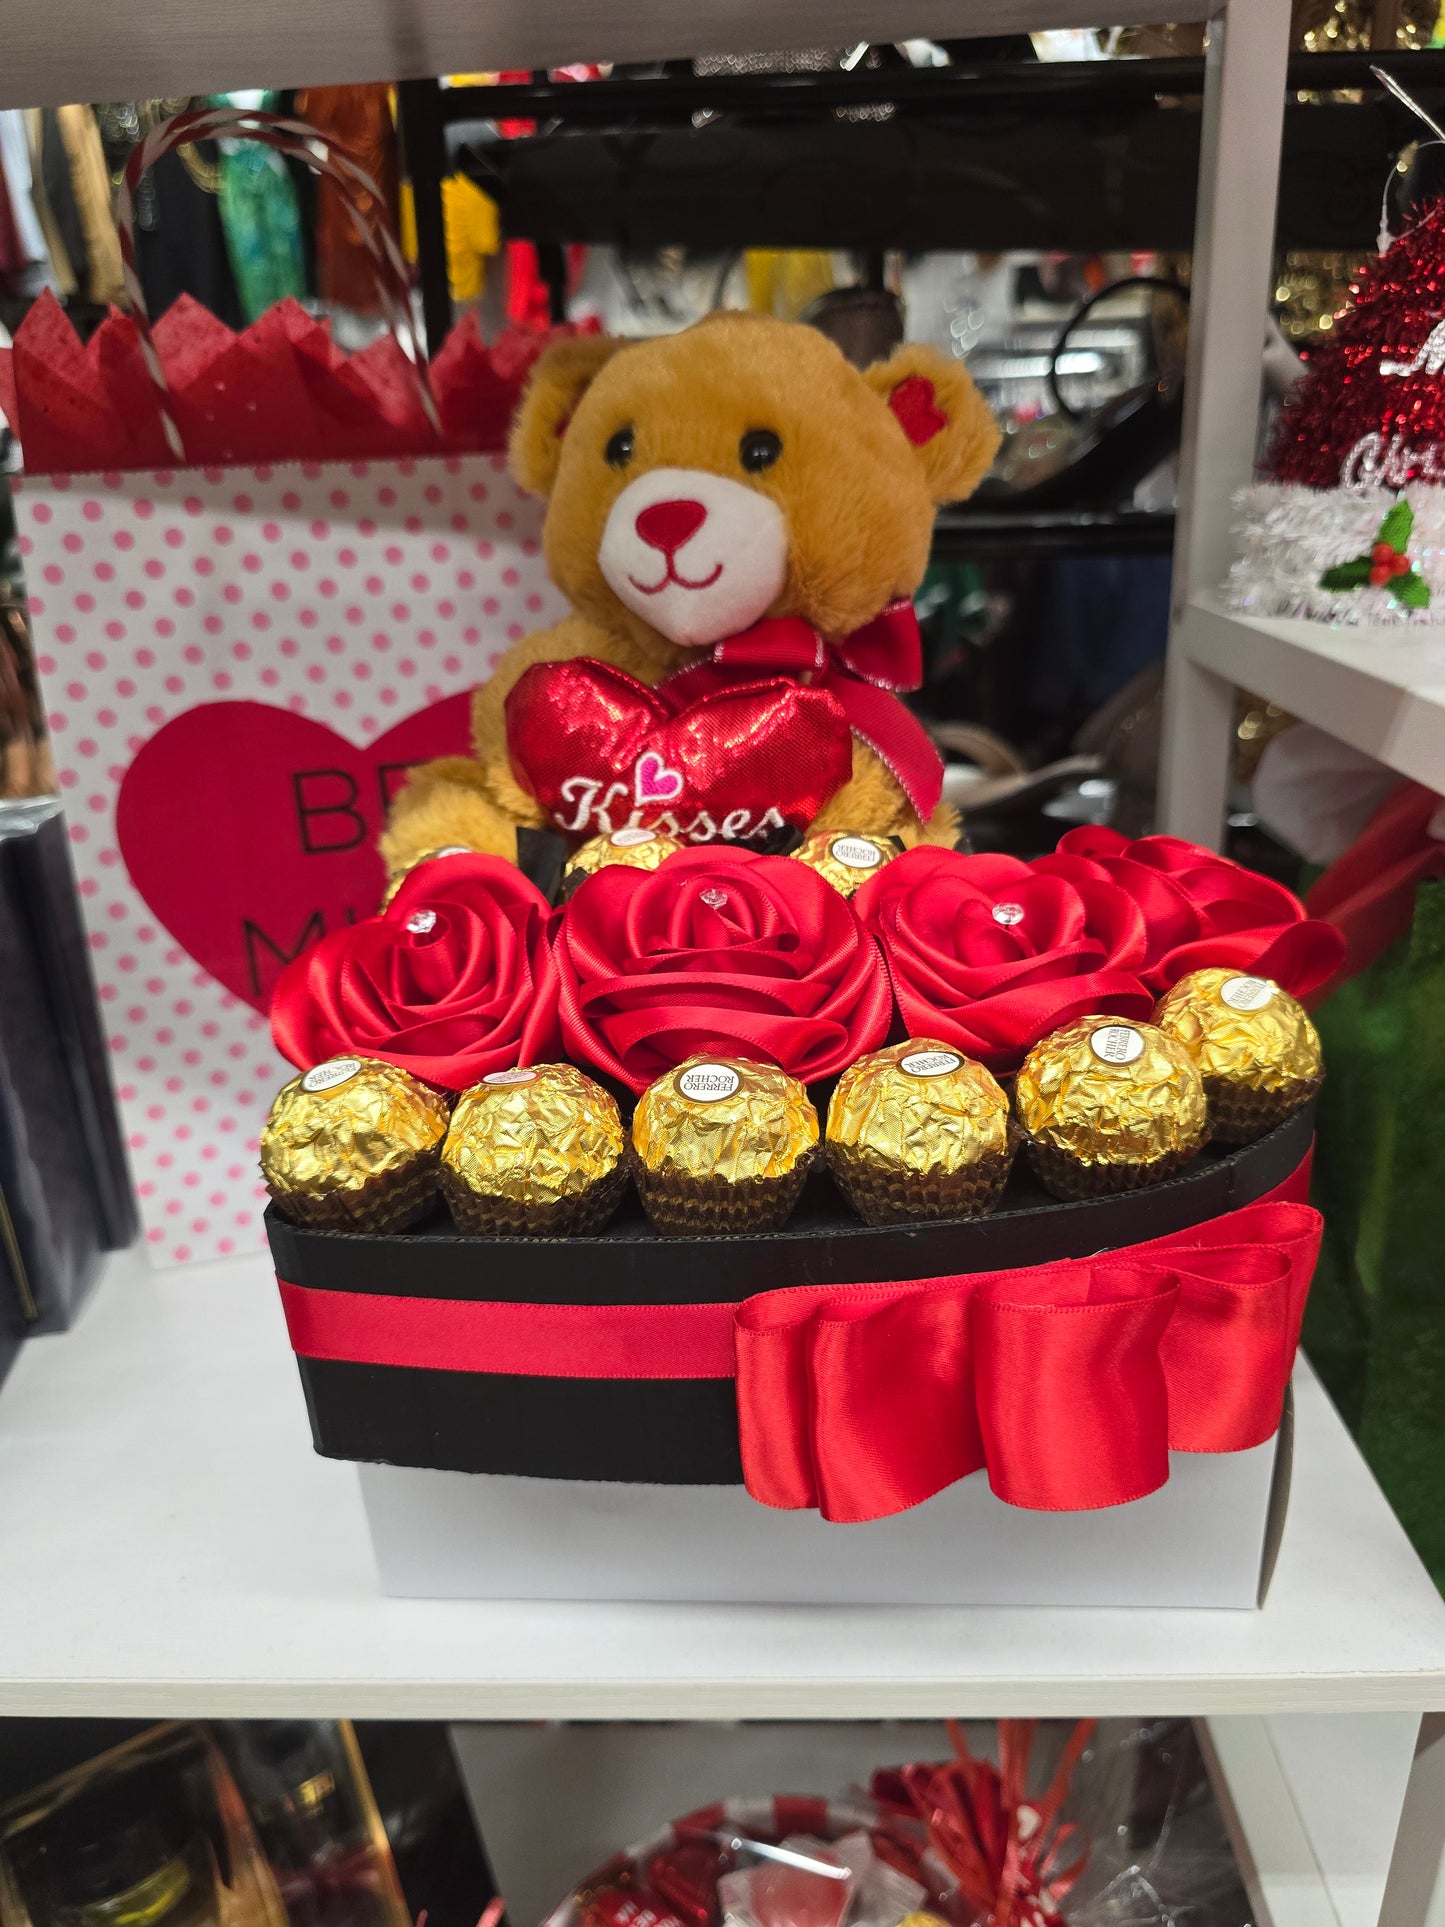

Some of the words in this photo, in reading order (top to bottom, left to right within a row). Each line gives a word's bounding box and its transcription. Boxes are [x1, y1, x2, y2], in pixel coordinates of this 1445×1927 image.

[554, 775, 785, 842] Kisses
[685, 1074, 735, 1084] ROCHER
[683, 1082, 734, 1092] FERRERO
